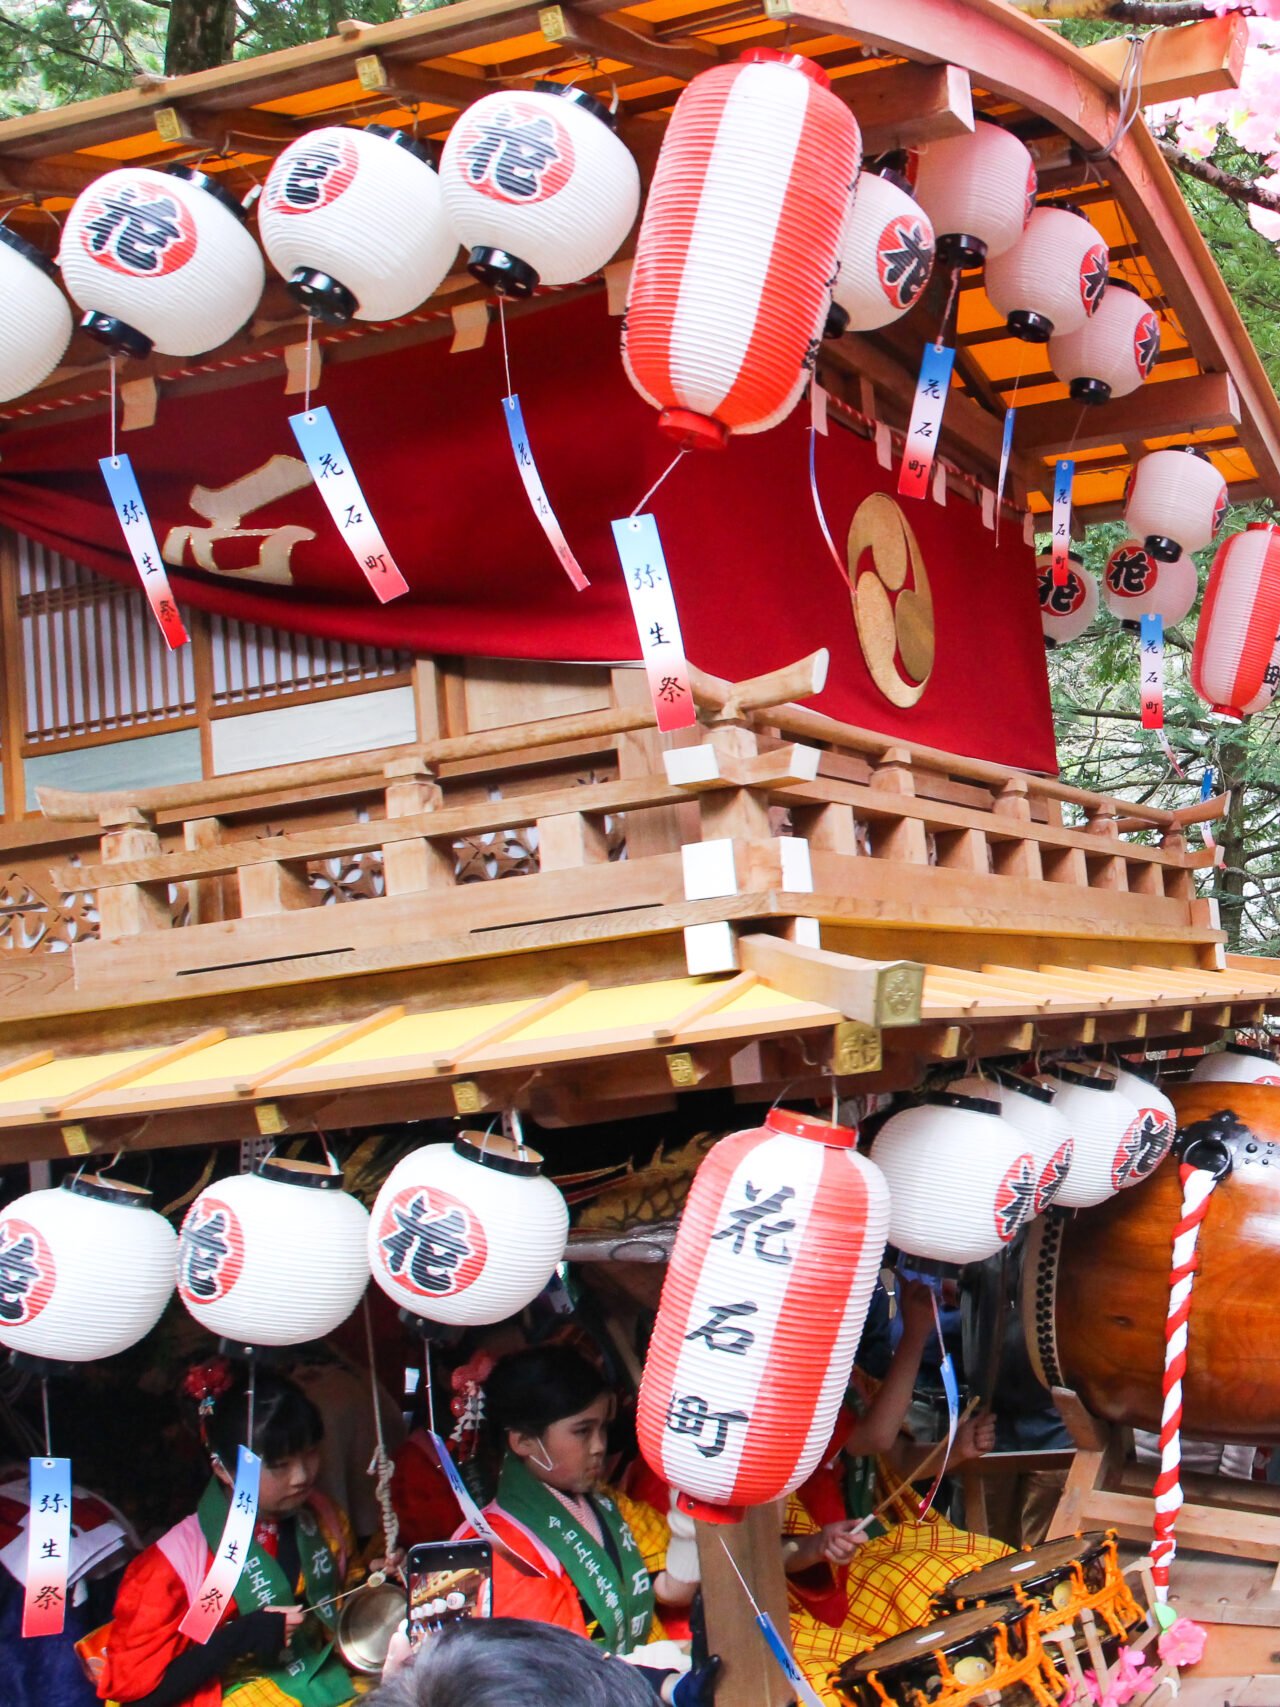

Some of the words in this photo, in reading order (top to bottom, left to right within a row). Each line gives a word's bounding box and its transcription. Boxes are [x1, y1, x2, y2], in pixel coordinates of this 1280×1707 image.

[460, 111, 558, 197] 花
[86, 186, 181, 271] 花
[907, 378, 941, 479] 花石町
[122, 500, 176, 623] 弥生祭
[318, 452, 389, 574] 花石町
[1054, 488, 1068, 570] 花石町
[1107, 551, 1150, 593] 花
[633, 563, 686, 703] 弥生祭
[1145, 638, 1160, 714] 花石町
[380, 1195, 473, 1291] 花
[665, 1180, 796, 1458] 花石町
[33, 1493, 69, 1611] 弥生祭
[200, 1490, 255, 1614] 弥生祭
